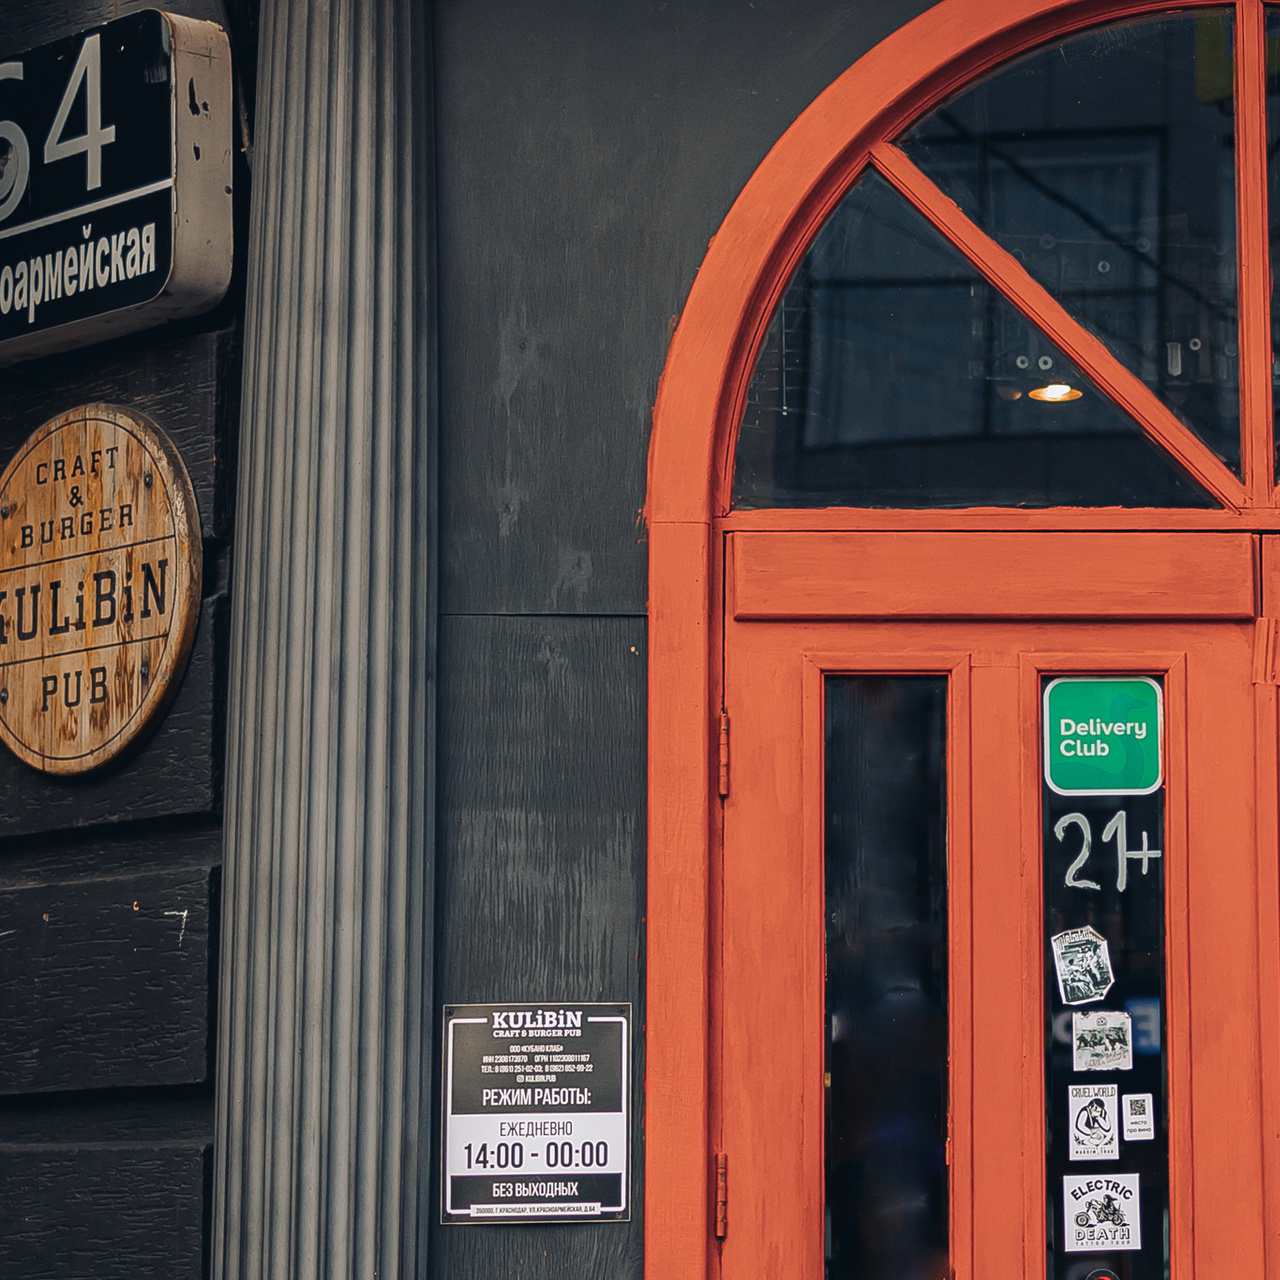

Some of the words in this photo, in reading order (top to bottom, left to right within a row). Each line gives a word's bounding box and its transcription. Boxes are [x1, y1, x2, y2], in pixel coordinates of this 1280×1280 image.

[36, 446, 119, 485] CRAFT
[69, 485, 85, 507] &
[21, 503, 134, 549] BURGER
[41, 666, 108, 712] PUB
[1059, 718, 1148, 739] Delivery
[1059, 739, 1110, 757] Club
[1054, 810, 1162, 892] 21+
[492, 1009, 582, 1029] KULiBiN
[493, 1029, 520, 1037] CRAFT
[528, 1029, 563, 1037] BURGER
[564, 1029, 582, 1037] PUB
[482, 1089, 532, 1106] РЕЖИМ
[534, 1088, 592, 1105] РАБОТЫ:
[1071, 1087, 1093, 1098] CRUEL
[1093, 1086, 1116, 1097] WORLD
[499, 1121, 573, 1137] ЕЖЕДНЕВНО
[464, 1142, 524, 1169] 14:00
[546, 1141, 609, 1167] 00:00
[492, 1183, 513, 1197] БЕЗ
[515, 1182, 579, 1197] ВЫХОДНЫХ
[1070, 1179, 1133, 1201] ELECTRIC
[1075, 1228, 1130, 1241] DEATH
